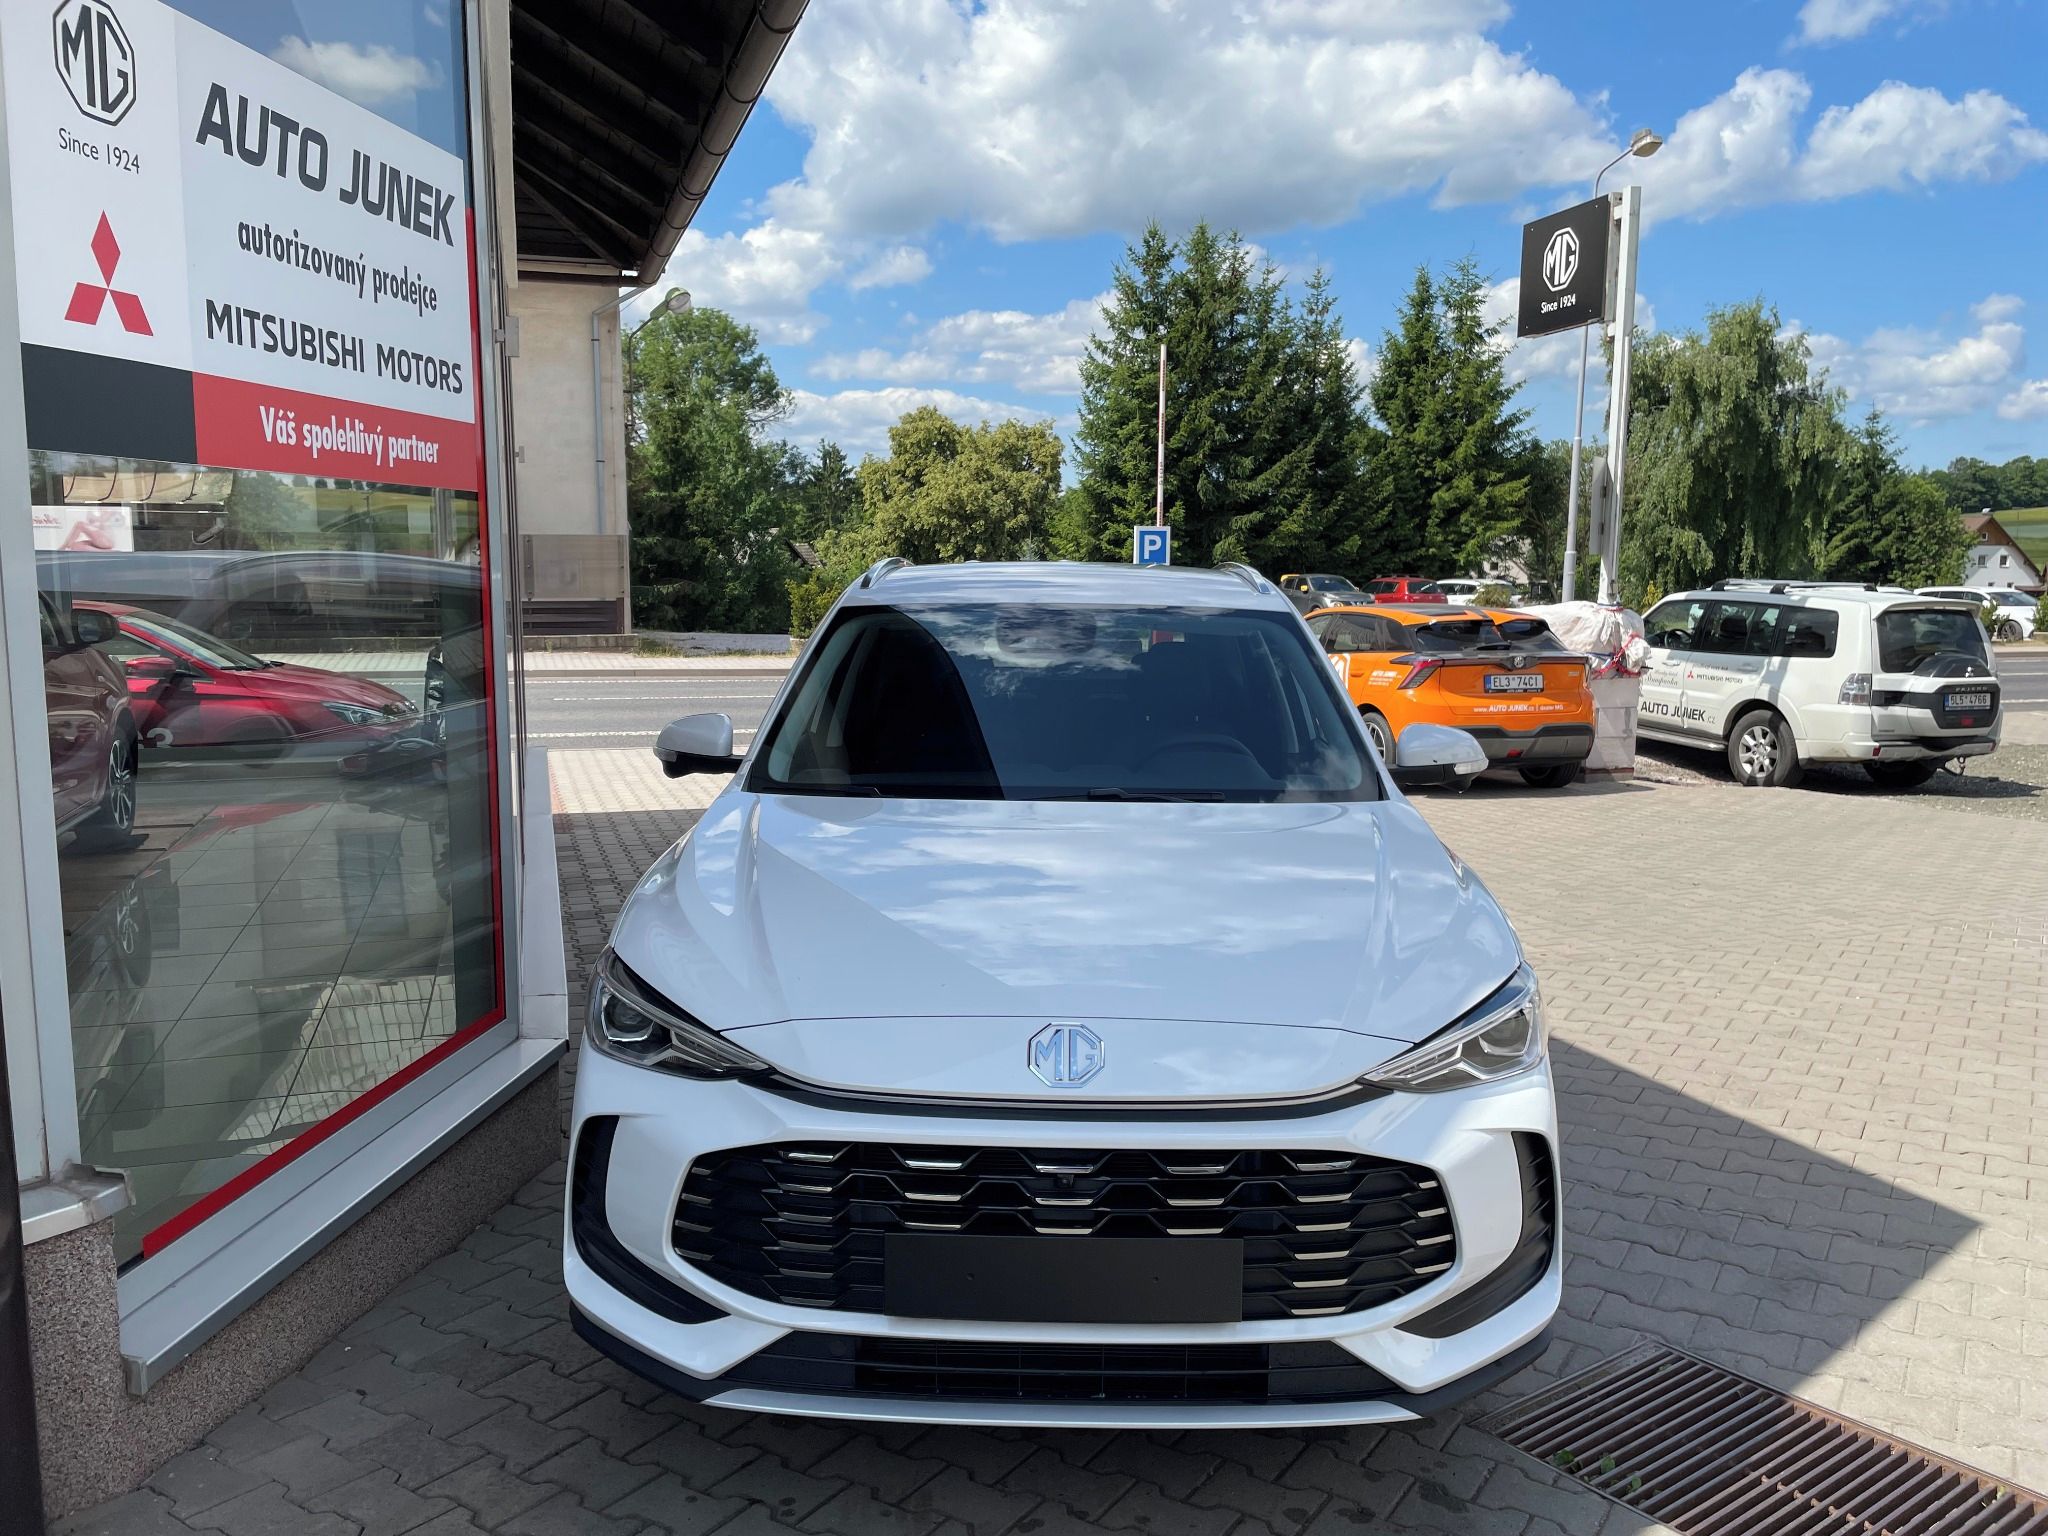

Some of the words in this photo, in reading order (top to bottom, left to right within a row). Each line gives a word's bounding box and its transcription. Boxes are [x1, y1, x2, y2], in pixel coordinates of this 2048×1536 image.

[61, 4, 129, 114] MG
[58, 127, 99, 160] Since
[106, 143, 140, 174] 1924
[196, 82, 329, 192] AUTO
[339, 149, 456, 247] JUNEK
[237, 220, 366, 299] autorizovaný
[372, 265, 437, 318] prodejce
[1546, 233, 1576, 286] MG
[1540, 300, 1558, 314] Since
[1559, 293, 1576, 308] 1924
[205, 298, 365, 373] MITSUBISHI
[376, 343, 463, 394] MOTORS
[259, 405, 297, 446] Váš
[302, 415, 383, 466] spolehlivý
[388, 434, 439, 468] partner
[1143, 534, 1162, 560] P
[1696, 674, 1724, 682] MITSUBISHI
[1640, 701, 1669, 716] AUTO
[1035, 1028, 1098, 1081] MG
